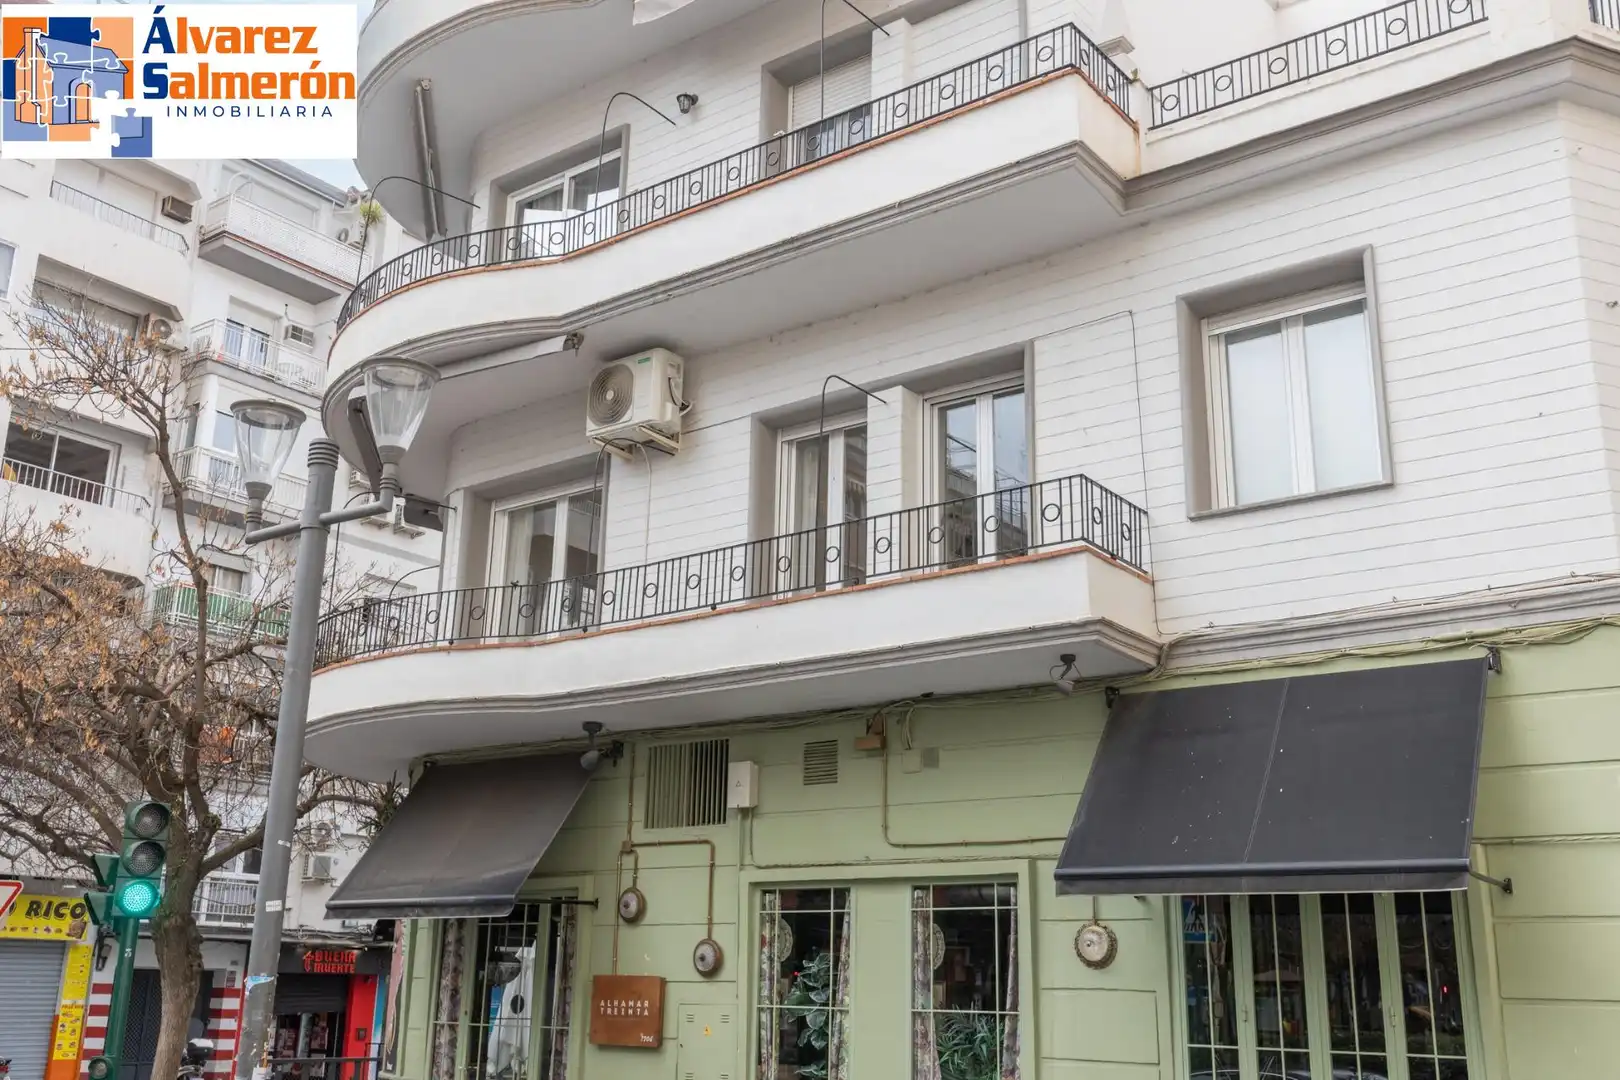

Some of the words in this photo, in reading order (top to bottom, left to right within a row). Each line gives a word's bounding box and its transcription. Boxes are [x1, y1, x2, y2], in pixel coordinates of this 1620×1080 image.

[25, 900, 87, 920] RICO
[314, 950, 357, 962] BUENA
[314, 962, 355, 973] MUERTE
[599, 999, 650, 1008] ALHAMAR
[600, 1007, 650, 1017] TREINTA
